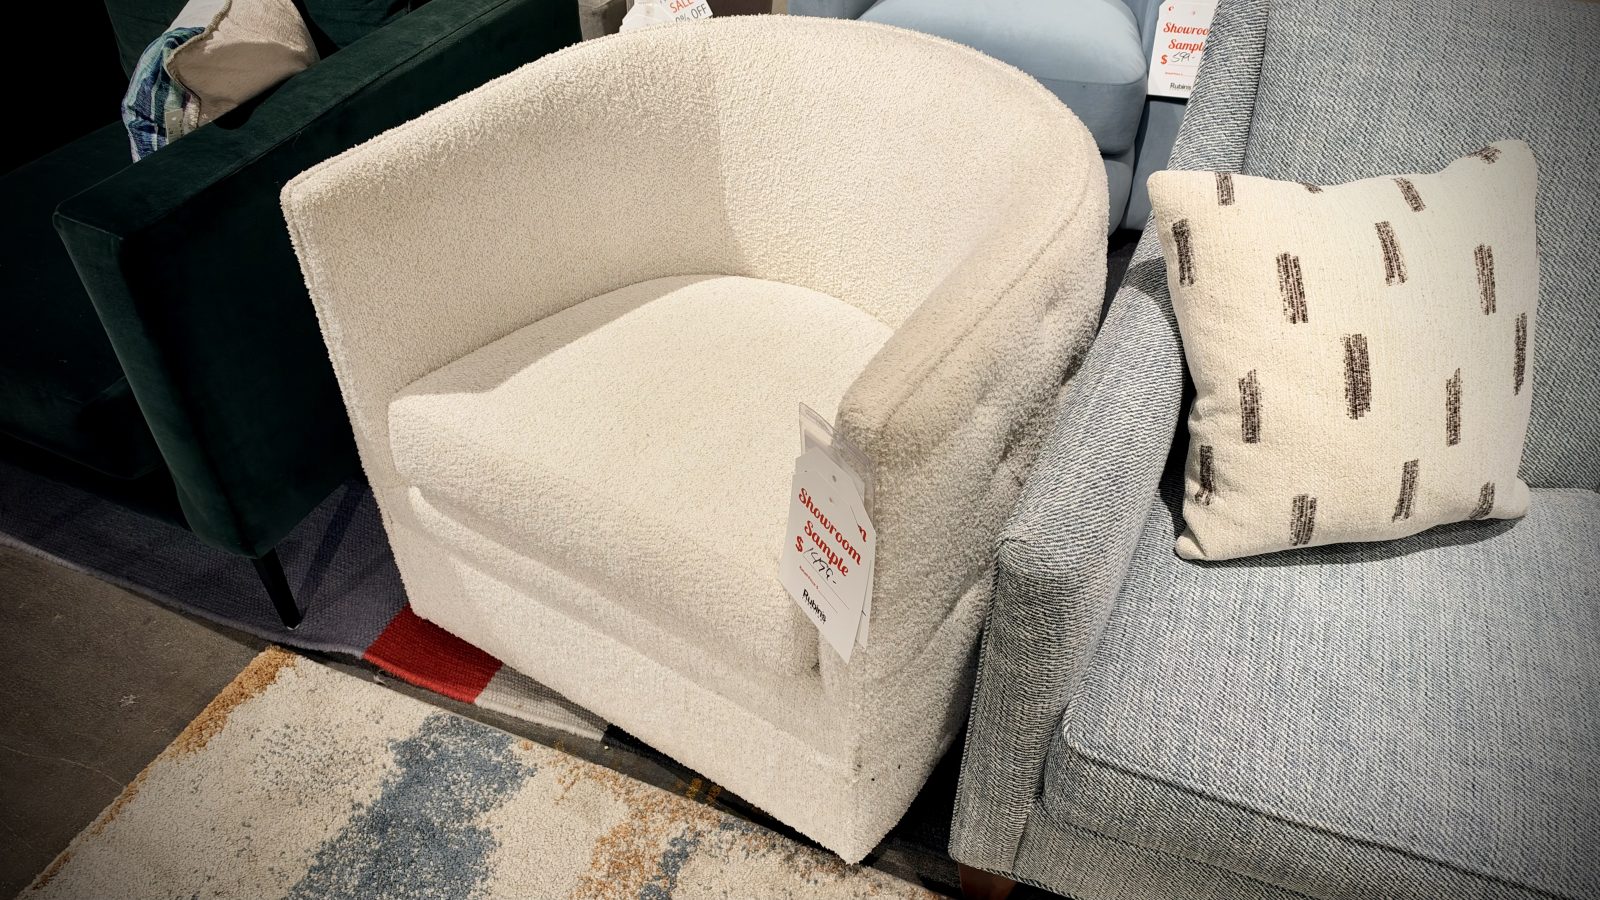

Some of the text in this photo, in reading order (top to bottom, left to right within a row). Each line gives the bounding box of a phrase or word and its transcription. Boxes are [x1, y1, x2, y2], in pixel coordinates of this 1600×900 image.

[691, 4, 707, 19] OFF
[1163, 22, 1210, 36] Showroo
[1168, 39, 1205, 54] Sampl
[1160, 54, 1168, 65] $
[1169, 82, 1192, 91] Rubins
[798, 487, 862, 566] Showroom
[795, 535, 804, 553] $
[804, 520, 849, 577] Sample
[803, 588, 826, 622] Rubins
